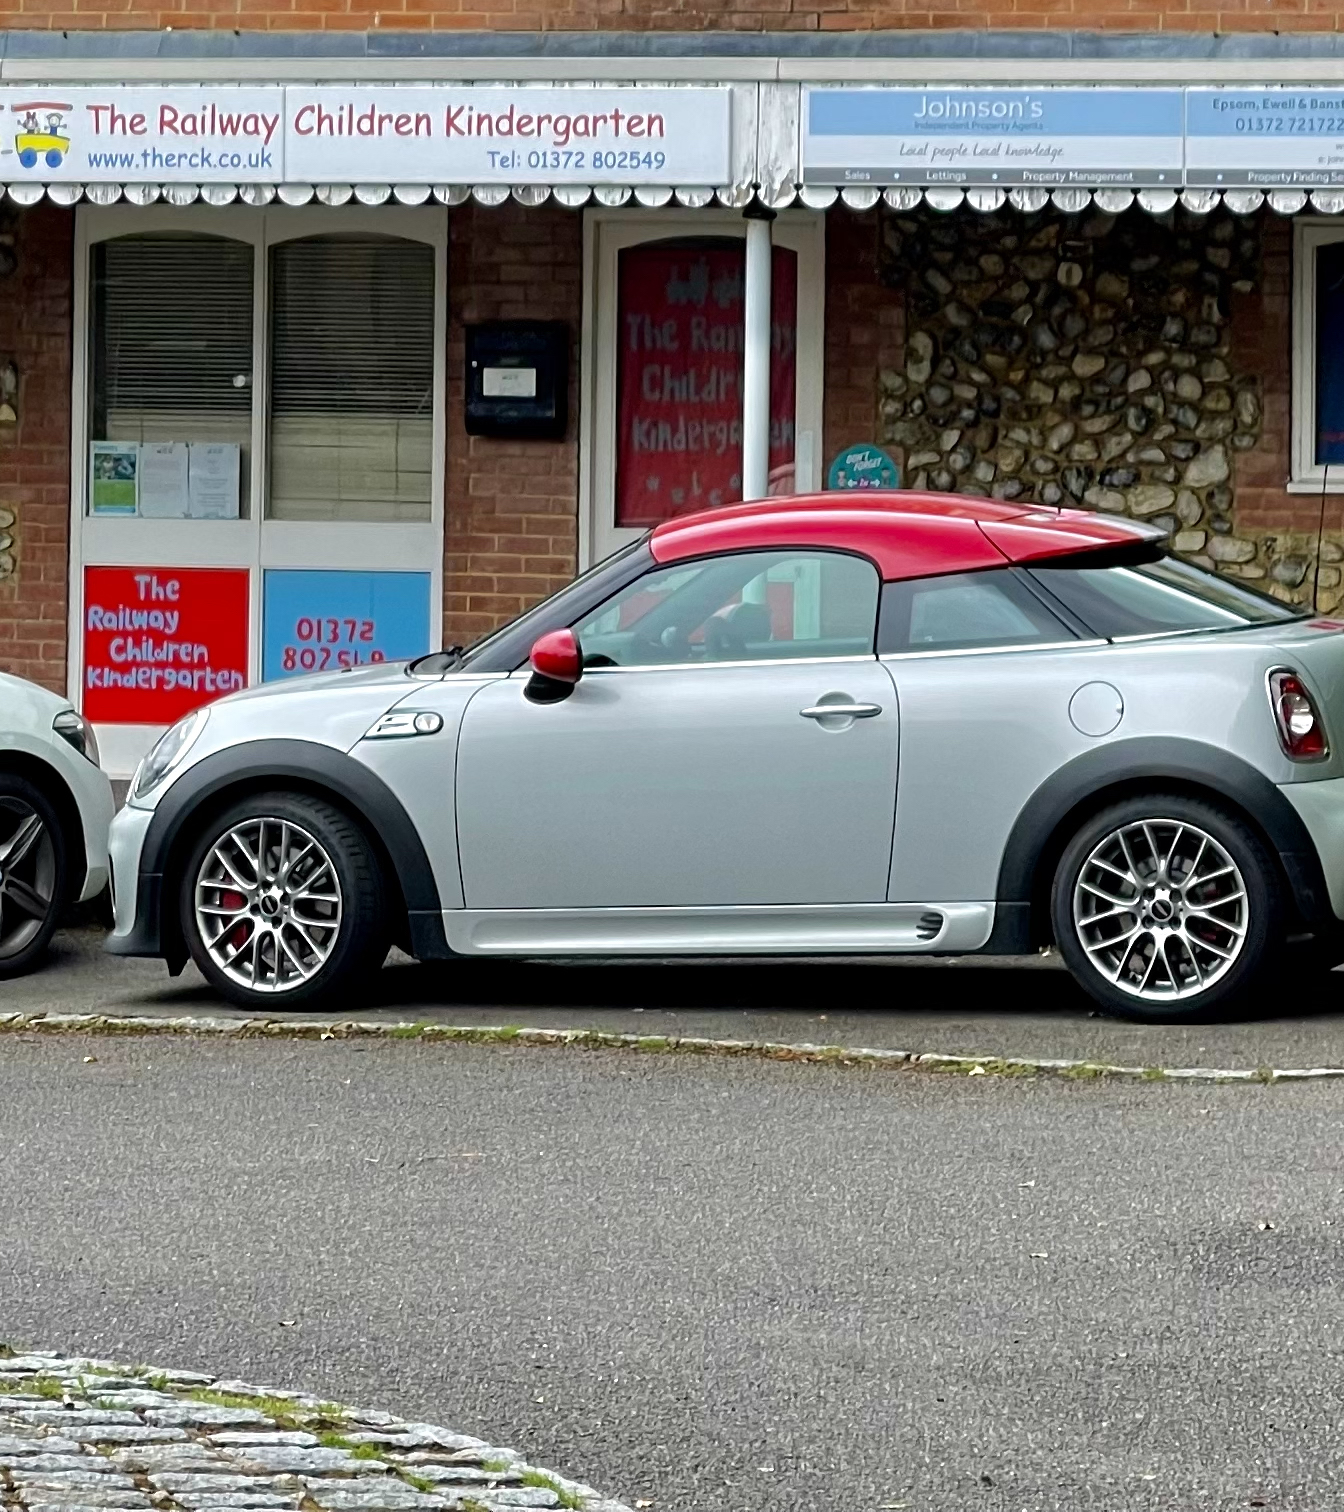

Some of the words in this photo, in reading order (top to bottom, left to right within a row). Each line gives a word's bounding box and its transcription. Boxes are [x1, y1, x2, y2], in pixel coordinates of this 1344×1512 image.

[913, 95, 1044, 119] Johnson's
[1212, 98, 1260, 112] Epsom,
[1262, 98, 1296, 110] Ewell
[1298, 98, 1307, 110] &
[86, 103, 147, 136] The
[159, 103, 280, 146] Railway
[294, 103, 432, 137] Children
[445, 103, 665, 146] Kindergarten
[914, 121, 970, 130] Independent
[971, 121, 1010, 131] Property
[1011, 121, 1044, 131] Agents
[1236, 117, 1284, 132] 01372
[1288, 117, 1344, 132] 721722
[87, 147, 273, 168] www.therck.co.uk
[487, 150, 521, 169] Tel:
[527, 150, 586, 169] 01372
[592, 150, 666, 170] 802549
[899, 142, 927, 157] Local
[931, 143, 968, 162] people
[972, 142, 1003, 157] Local
[1005, 143, 1064, 162] knowledge
[845, 170, 871, 181] Sales
[926, 170, 967, 182] Lettings
[1023, 171, 1066, 183] Property
[1069, 171, 1134, 183] Management
[1248, 172, 1291, 184] Property
[1293, 172, 1329, 184] Finding
[626, 313, 678, 353] The
[134, 574, 180, 601] The
[87, 603, 179, 634] Railway
[296, 617, 374, 643] 01372
[109, 636, 208, 663] Children
